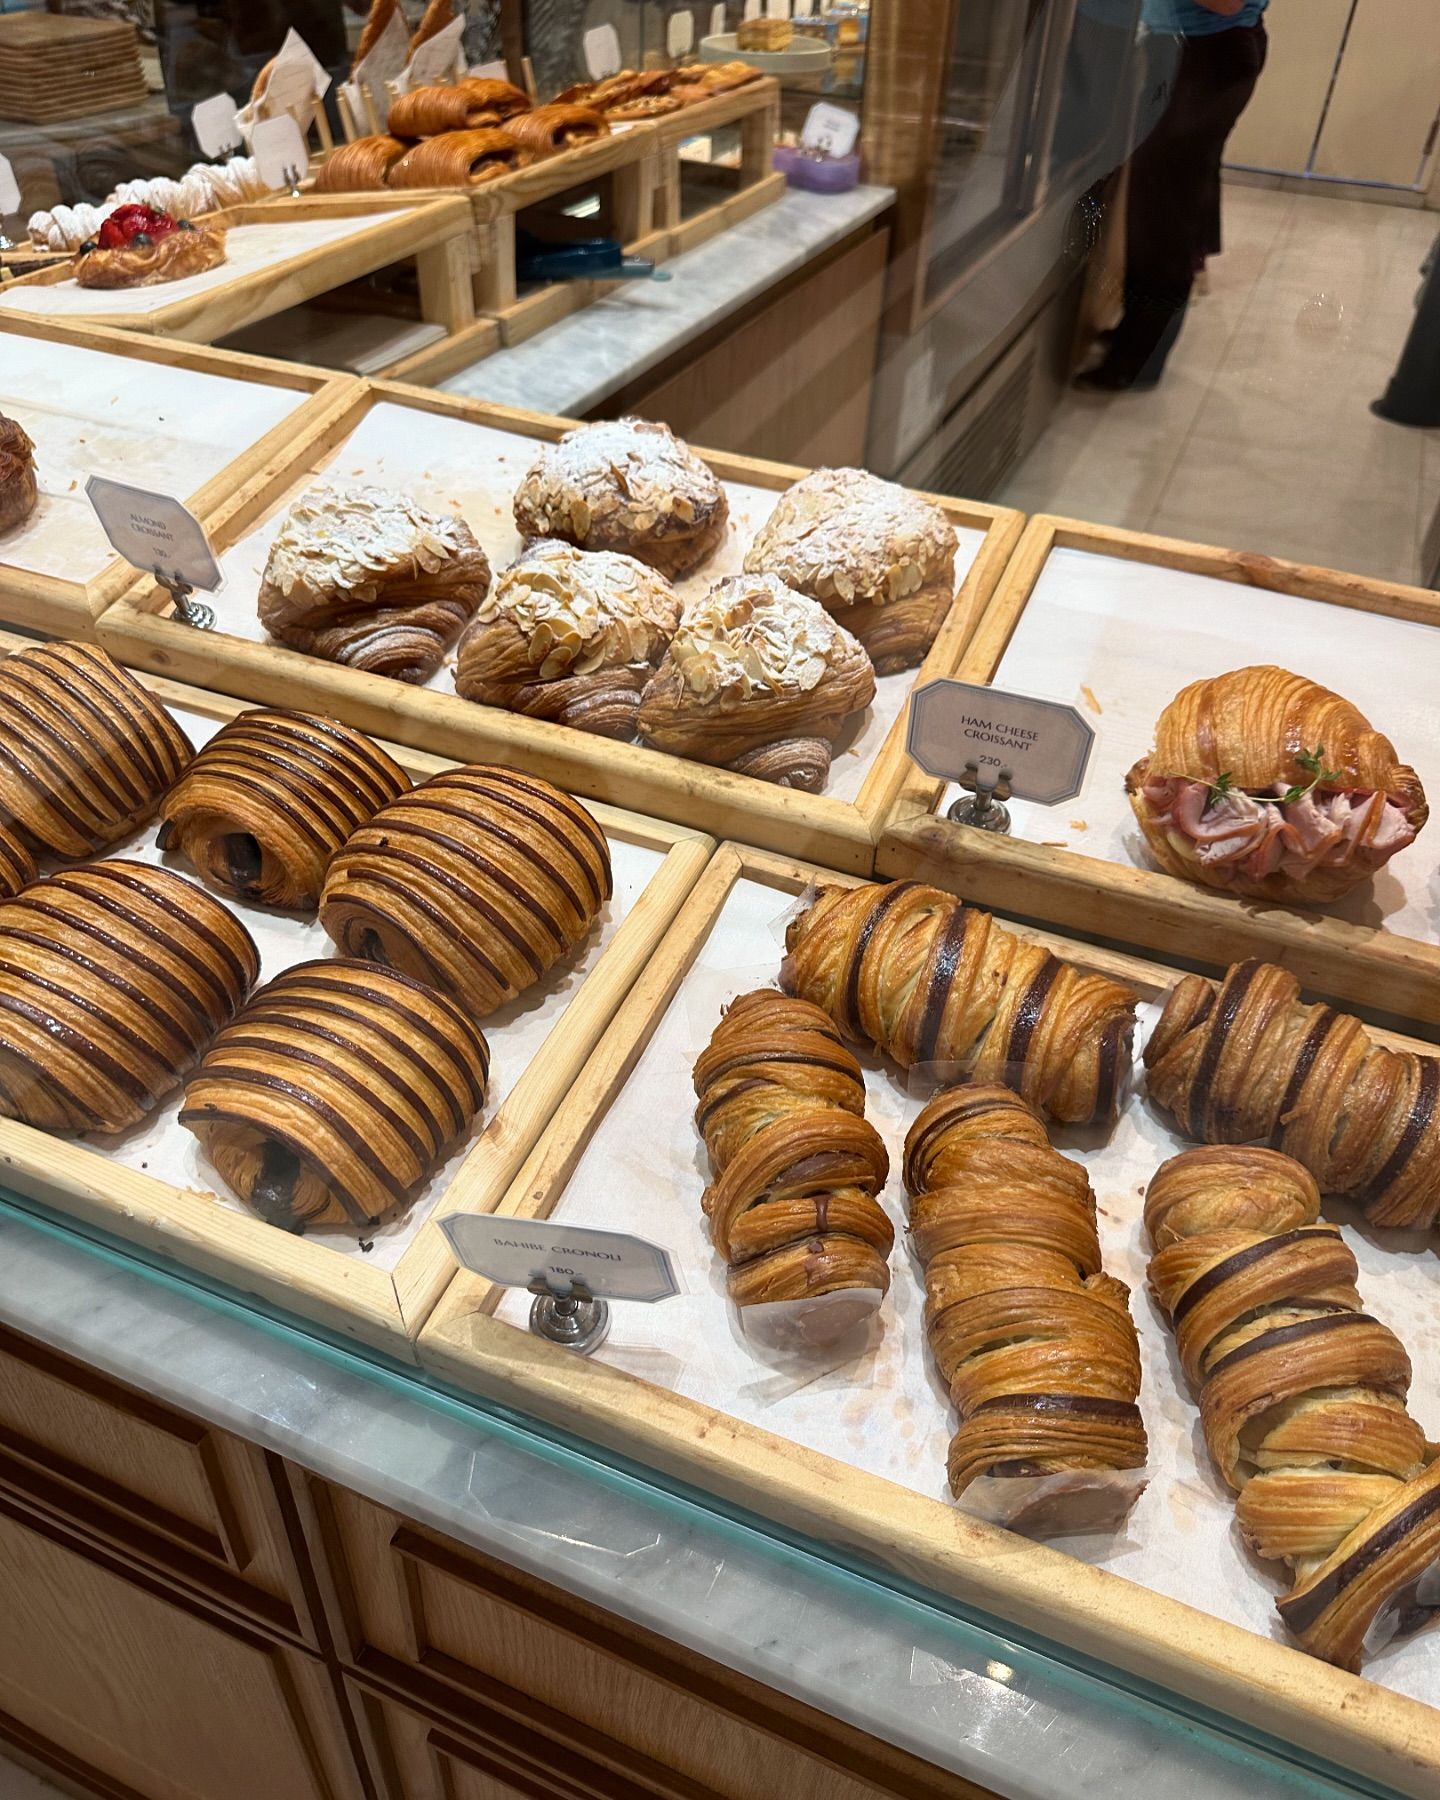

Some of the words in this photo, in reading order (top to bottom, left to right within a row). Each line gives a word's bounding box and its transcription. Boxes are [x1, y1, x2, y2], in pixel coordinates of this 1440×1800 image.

[130, 513, 167, 530] ALMOND
[961, 715, 992, 730] HAM
[995, 724, 1040, 741] CHEESE
[964, 728, 1032, 751] CROISSANT
[551, 1246, 622, 1262] CRONOLI
